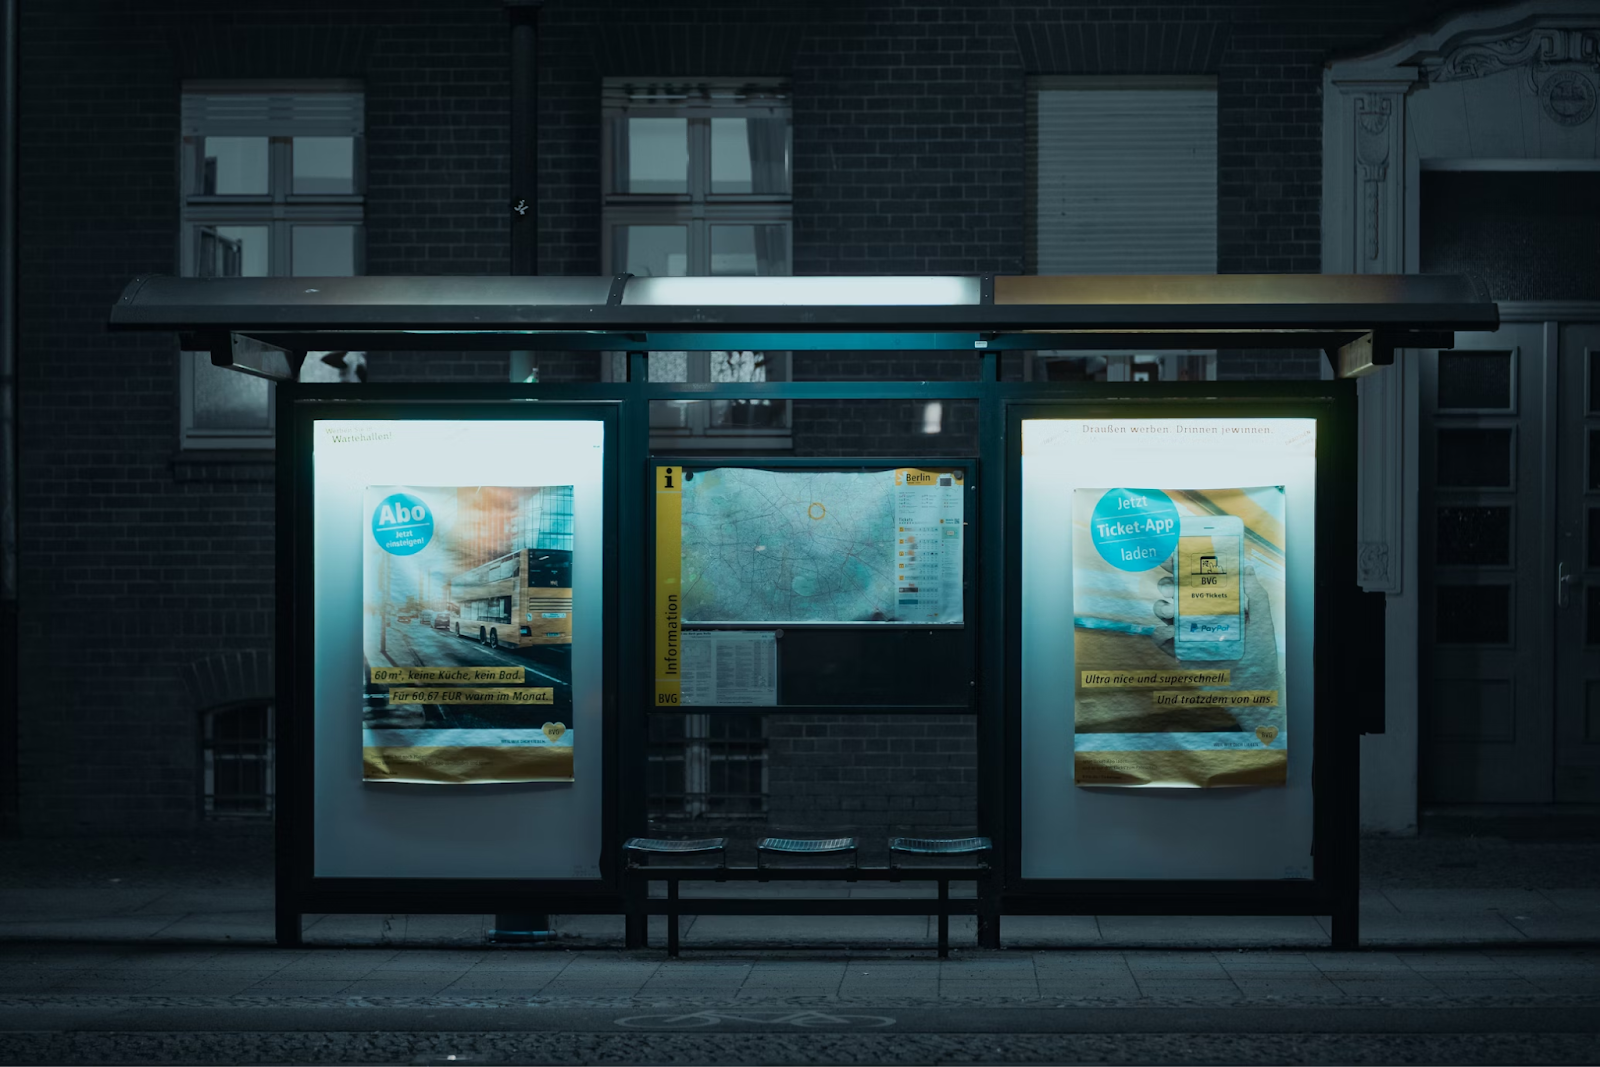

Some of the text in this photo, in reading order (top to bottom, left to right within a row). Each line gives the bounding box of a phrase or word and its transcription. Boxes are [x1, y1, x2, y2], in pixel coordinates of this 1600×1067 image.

[1082, 424, 1127, 434] Draußen
[1176, 424, 1218, 434] Drinnen
[332, 431, 392, 443] Wartehallen!
[906, 473, 931, 482] Berlin
[1117, 495, 1148, 510] Jetzt
[378, 502, 426, 526] Abo
[1097, 518, 1174, 538] Ticket-App
[395, 530, 413, 539] Jetzt
[386, 537, 424, 548] einsteigen!
[1121, 546, 1157, 561] laden
[1201, 576, 1217, 585] BVG
[1201, 624, 1230, 633] PayPal
[664, 594, 678, 675] Information
[408, 670, 435, 680] keine
[438, 670, 471, 681] Küche,
[474, 670, 496, 680] kein
[499, 670, 521, 680] Bad.
[1085, 673, 1227, 686] Ultra nice und superschnell.
[393, 691, 549, 702] Für 60,67 EUR warm im Monat.
[658, 693, 678, 704] BVG
[1157, 694, 1274, 705] Und trotzdem von uns.
